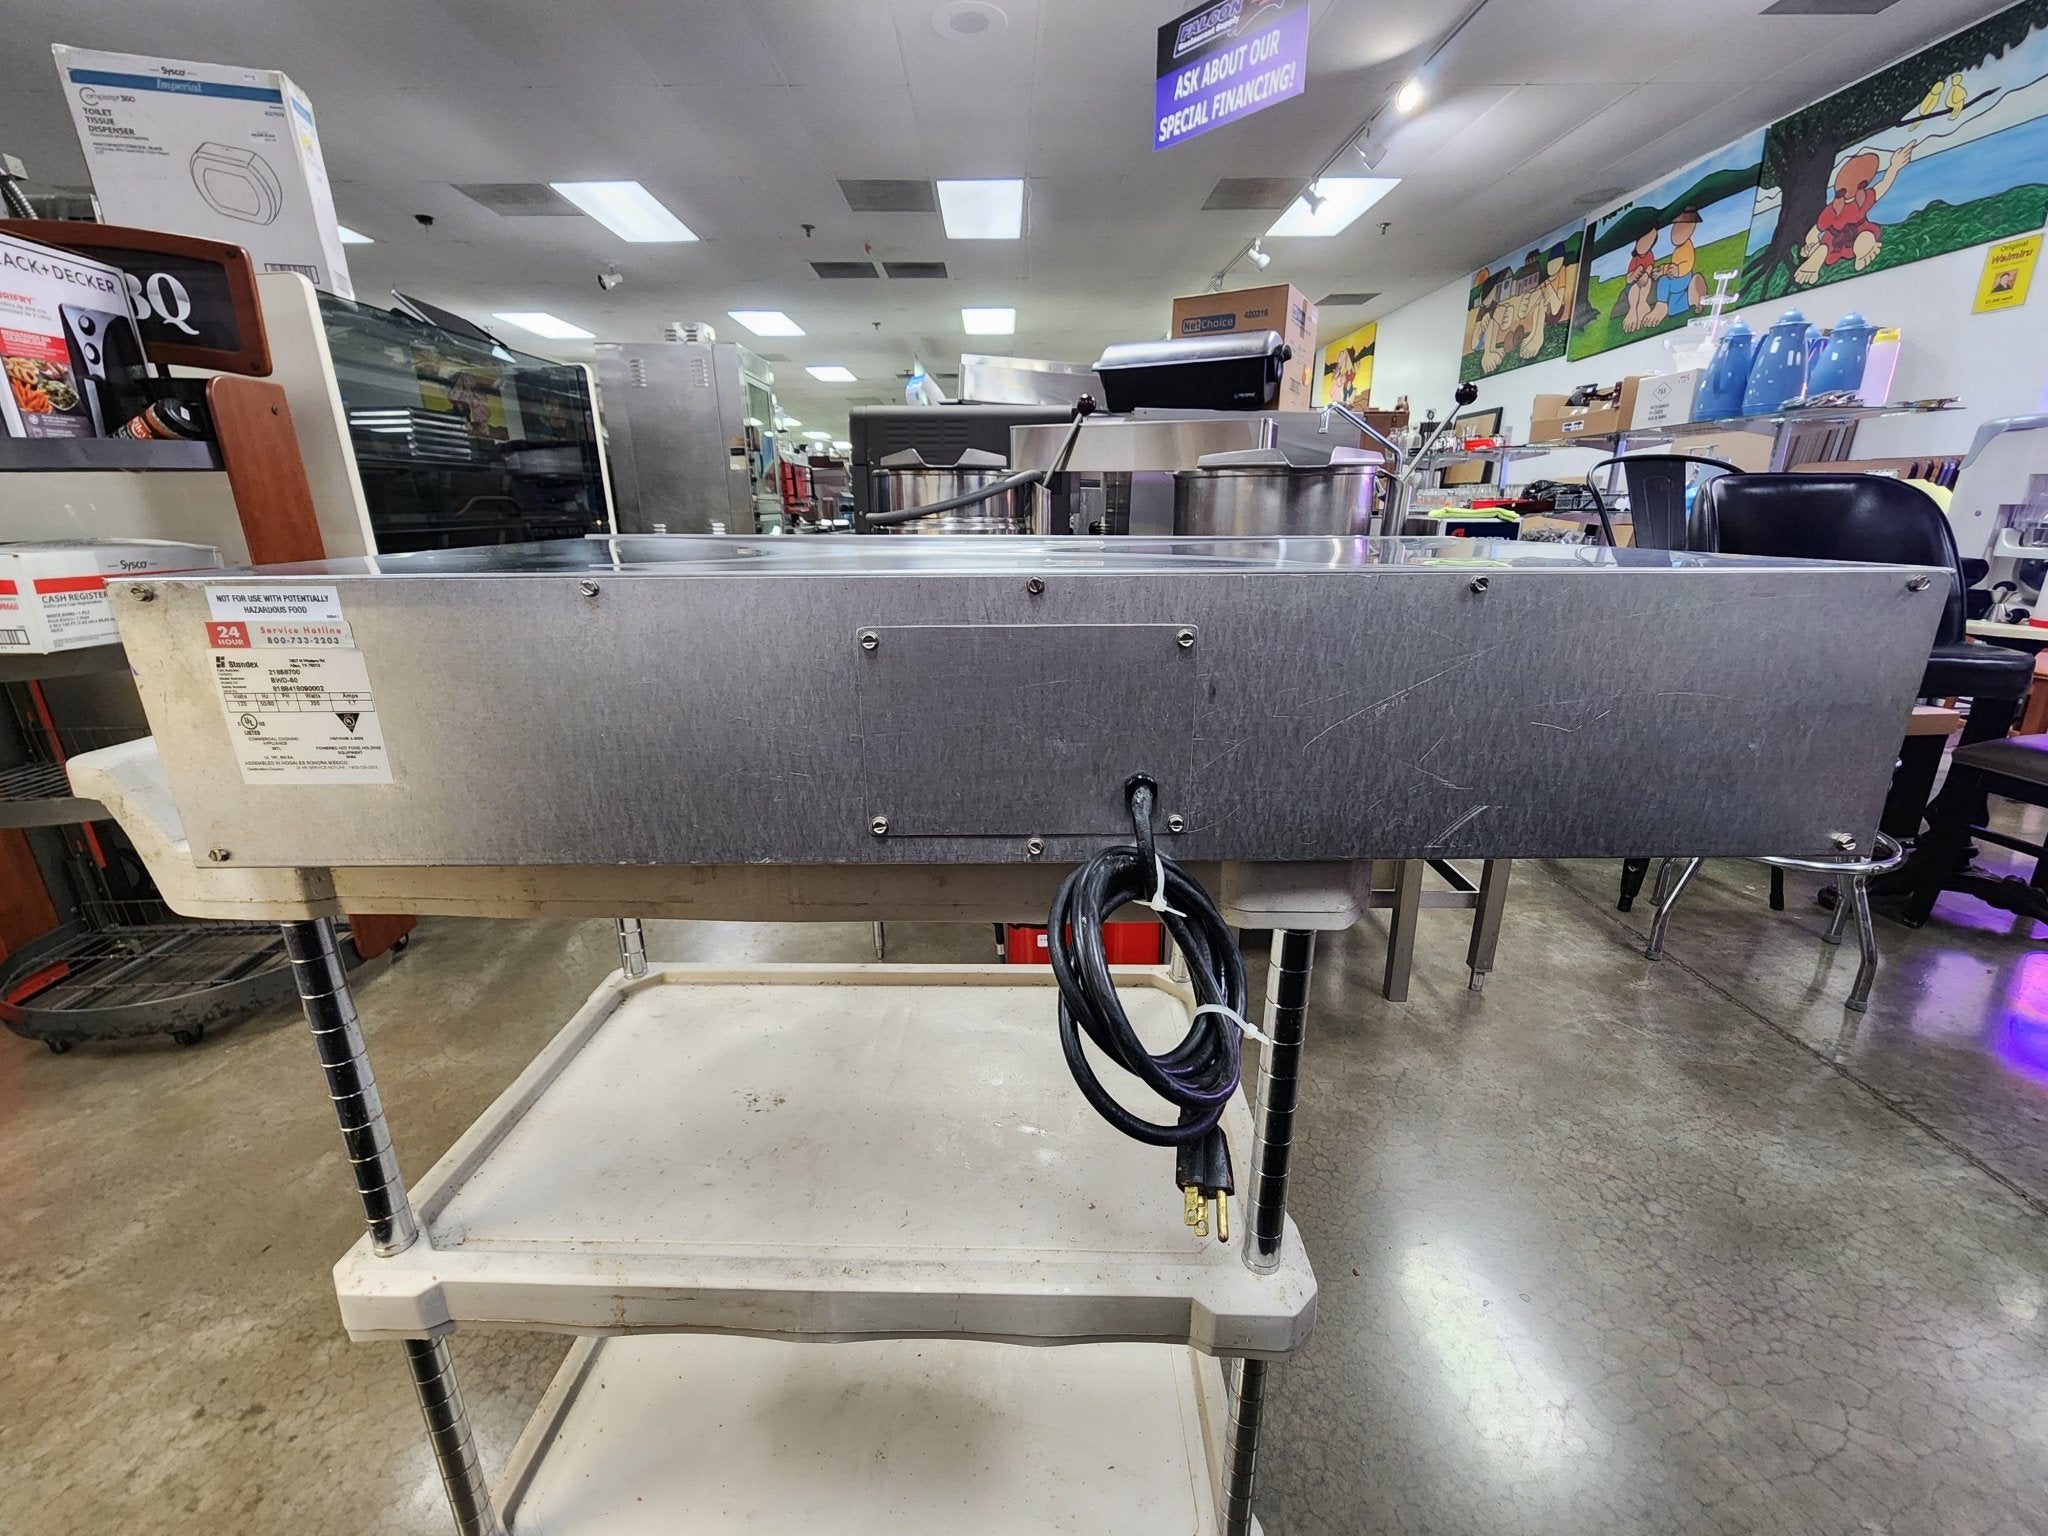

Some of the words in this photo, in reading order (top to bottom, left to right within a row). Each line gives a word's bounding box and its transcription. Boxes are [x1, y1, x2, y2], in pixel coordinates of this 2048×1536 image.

[1179, 0, 1243, 42] FALCON
[1216, 15, 1241, 33] Supply
[1174, 66, 1200, 100] ASK
[1201, 44, 1248, 89] ABOUT
[1249, 29, 1281, 66] OUR
[160, 66, 186, 76] Sysco
[156, 78, 202, 93] Imperial
[1158, 99, 1208, 142] SPECIAL
[1211, 61, 1297, 120] FINANCING!
[82, 106, 112, 116] TOILET
[85, 116, 115, 125] TISSUE
[88, 125, 136, 136] DISPENSER
[2000, 240, 2029, 252] Original
[0, 252, 116, 295] ACK+DECKER
[1183, 318, 1234, 331] NetChoice
[119, 559, 148, 572] Sysco
[41, 595, 67, 604] CASH
[215, 594, 230, 603] NOT
[231, 594, 246, 603] FOR
[248, 594, 262, 603] USE
[263, 594, 282, 603] WITH
[283, 594, 329, 603] POTENTIALLY
[243, 606, 287, 614] HAZARDOUS
[288, 606, 308, 614] FOOD
[216, 626, 240, 638] 24
[260, 626, 299, 635] Service
[303, 626, 342, 635] Hotline
[217, 638, 244, 646] HOUR
[266, 636, 340, 645] 800-733-2203
[228, 660, 259, 668] Standex
